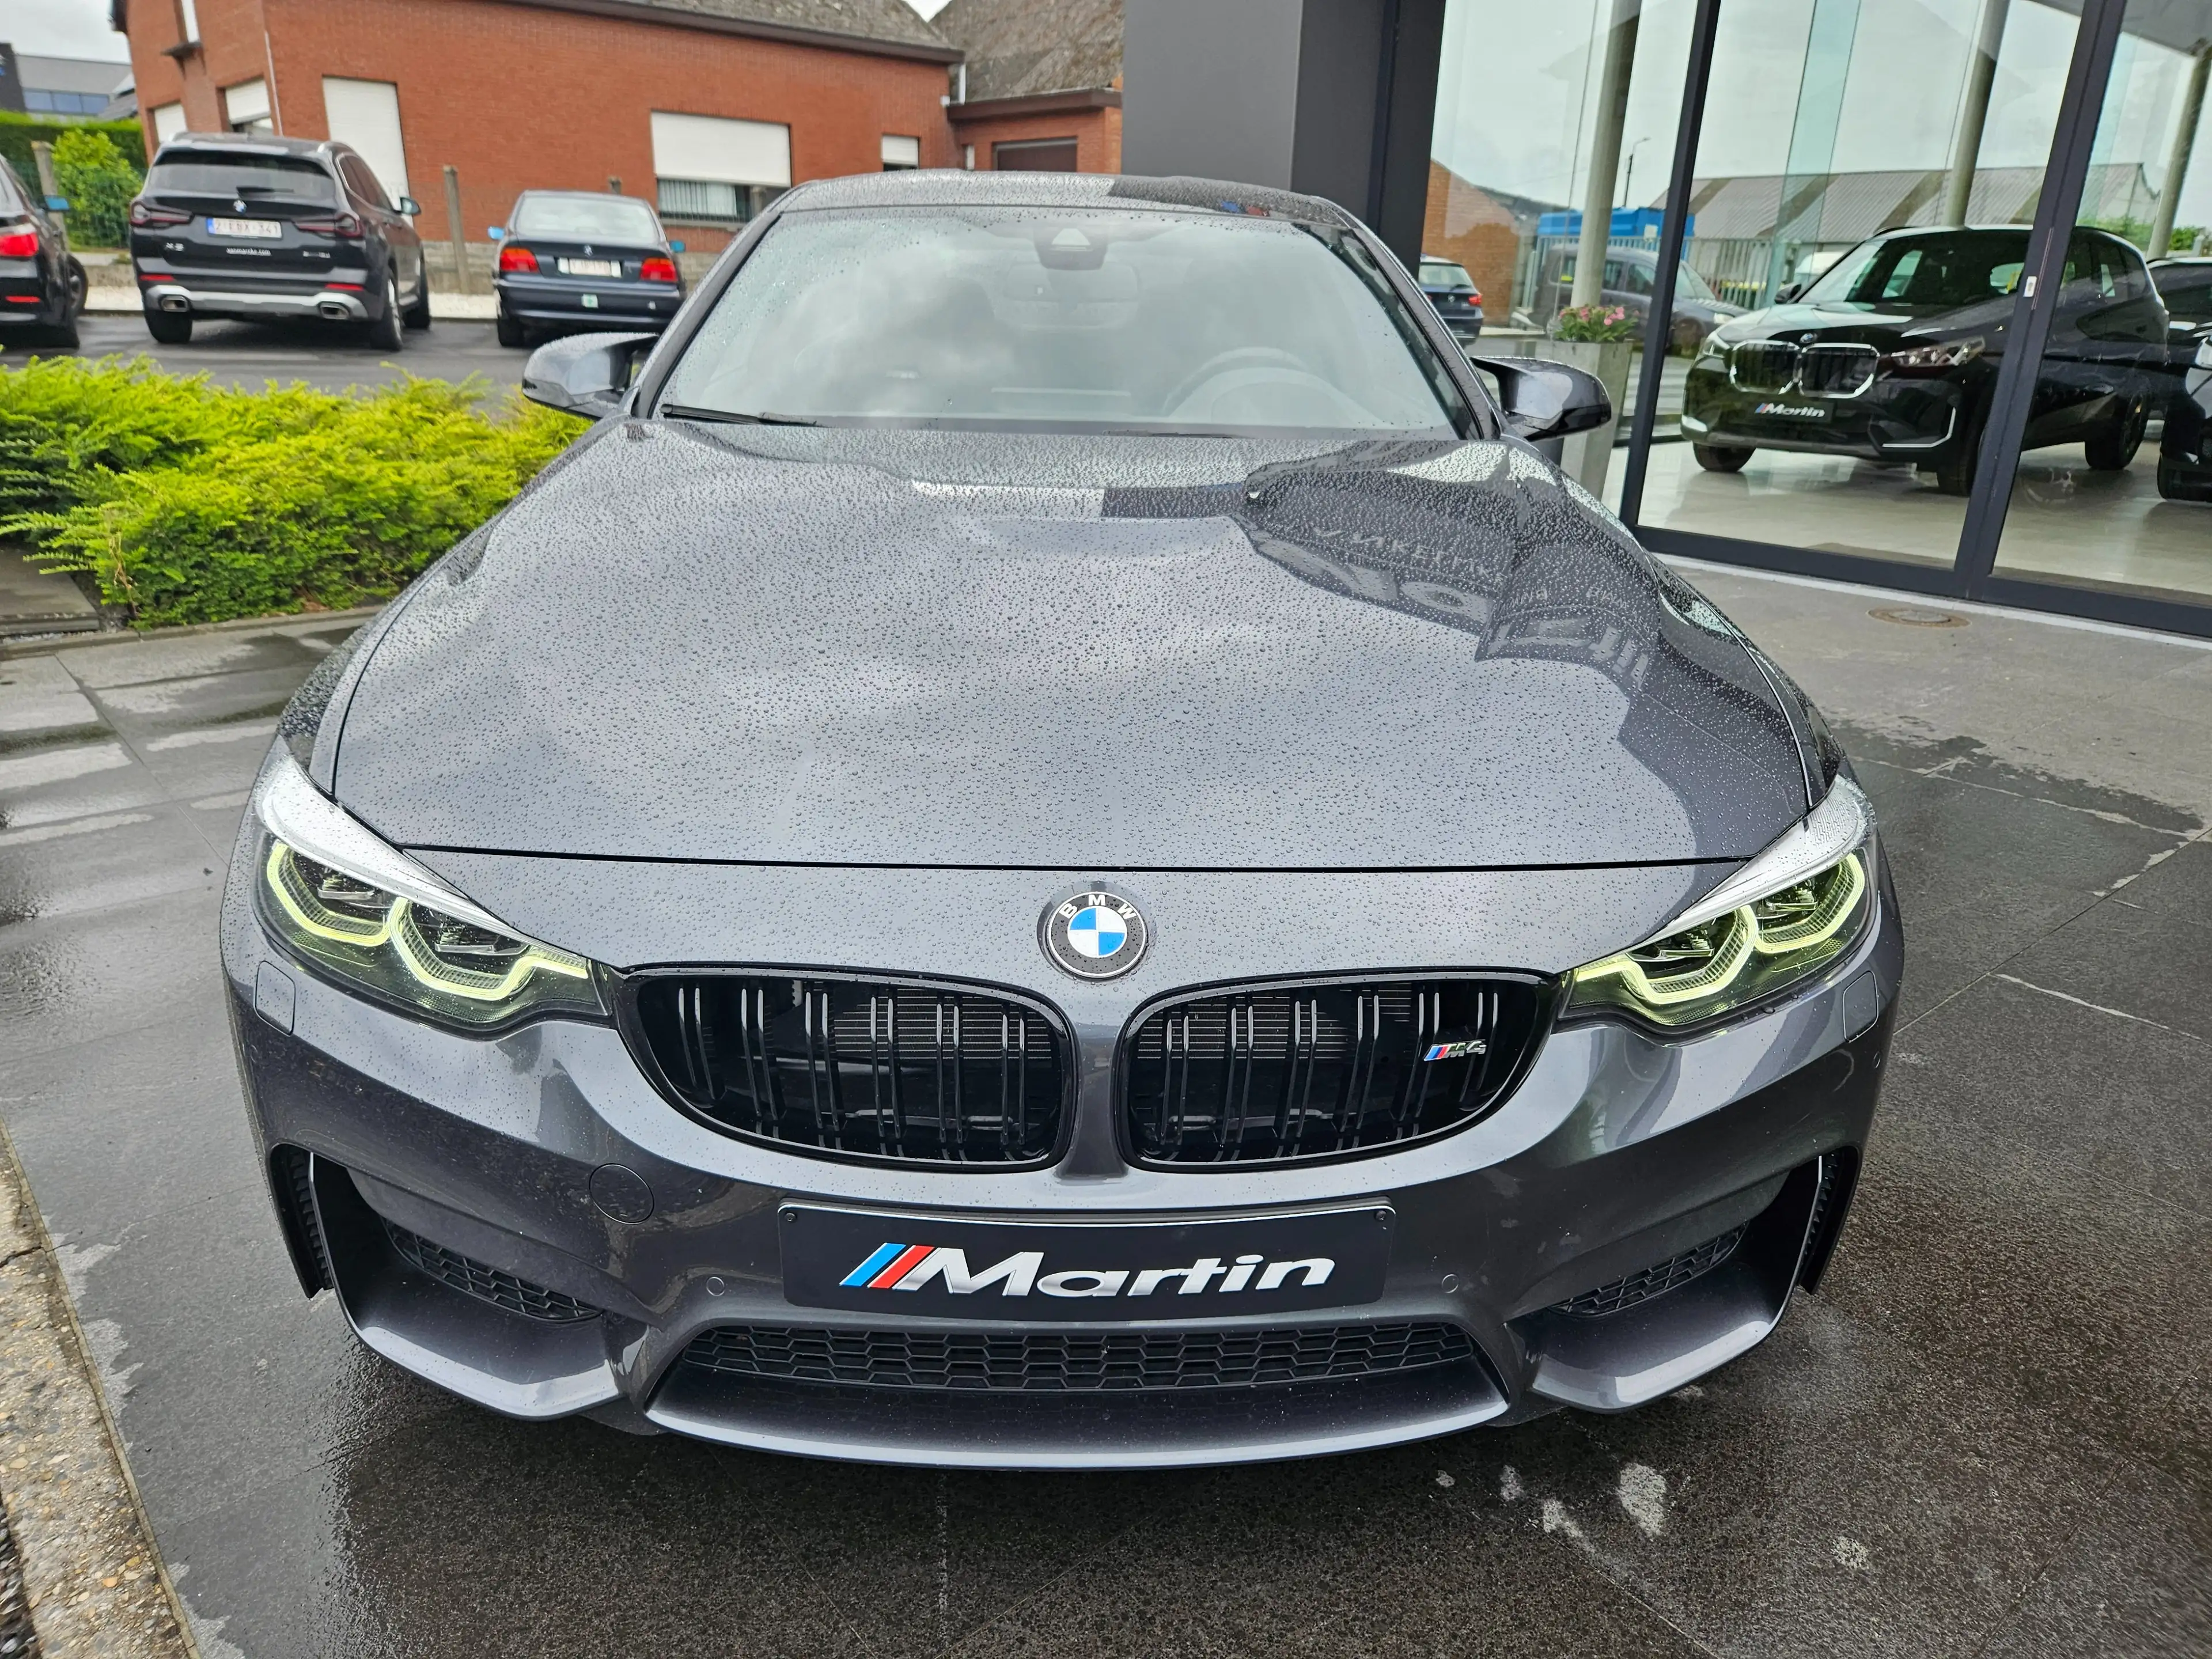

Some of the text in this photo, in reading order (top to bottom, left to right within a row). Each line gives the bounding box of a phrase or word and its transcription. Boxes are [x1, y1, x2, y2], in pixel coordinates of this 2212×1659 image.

[1761, 403, 1825, 417] Martin
[1058, 894, 1138, 919] BMW
[1440, 1040, 1487, 1058] M4
[892, 1247, 1335, 1297] Martin
